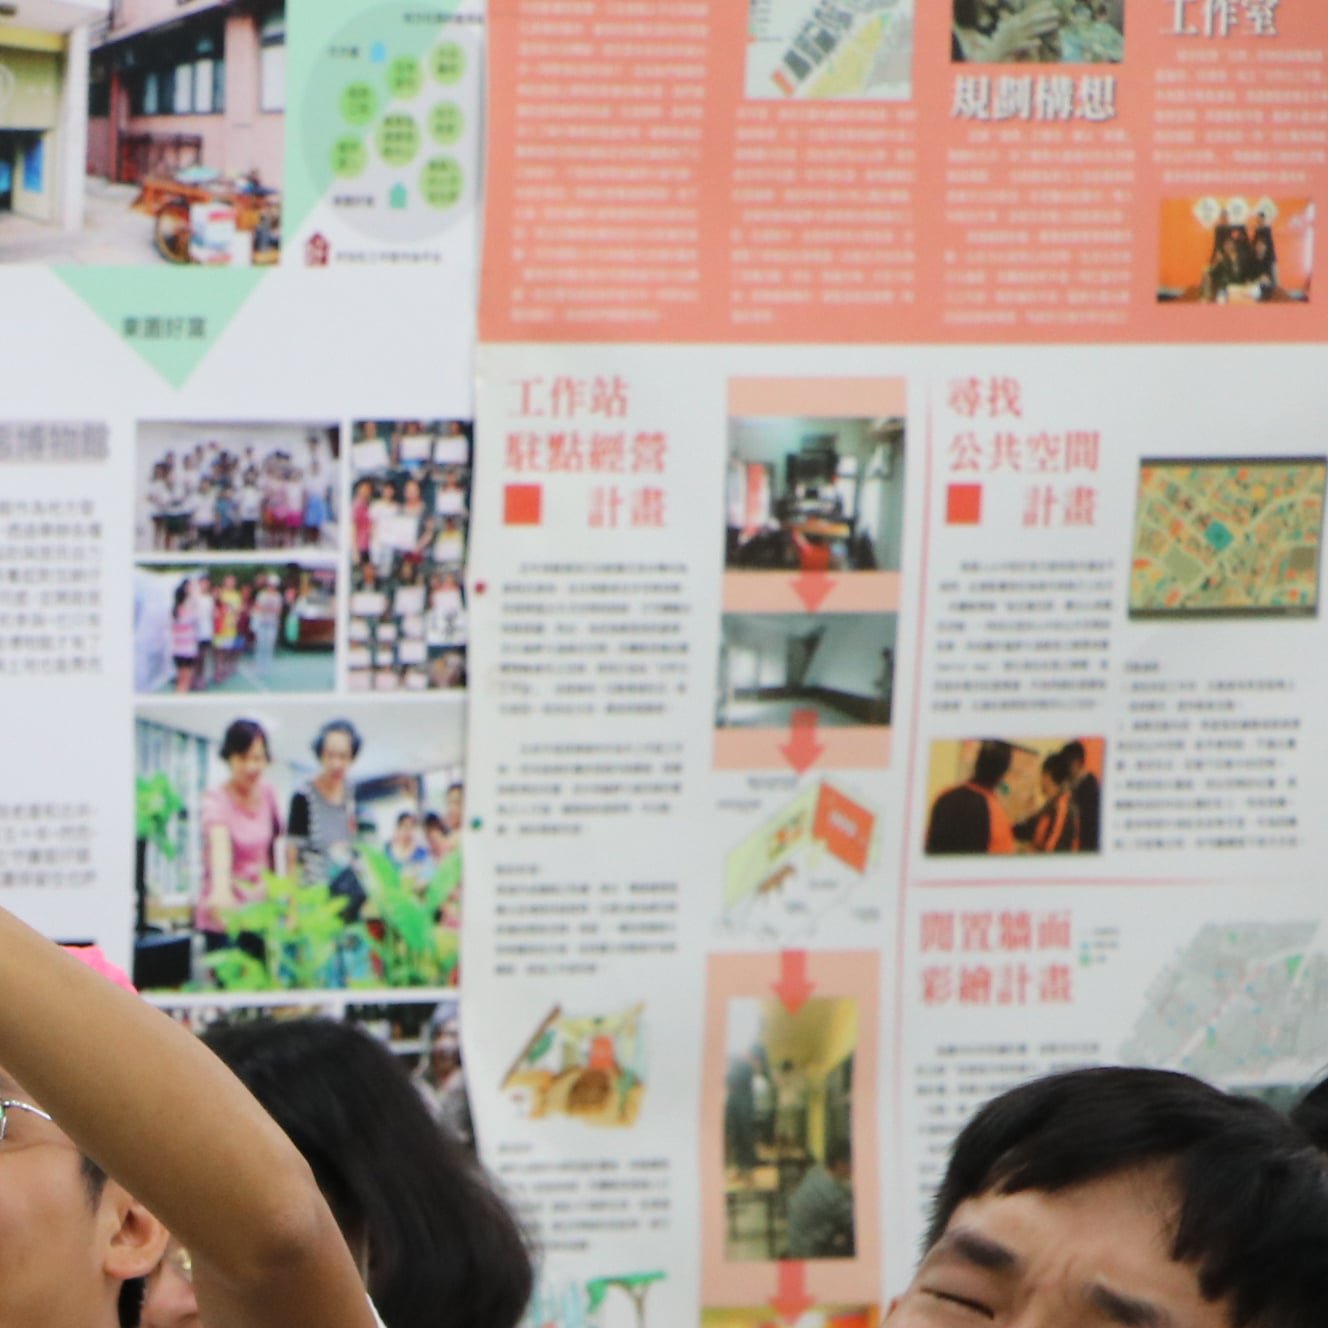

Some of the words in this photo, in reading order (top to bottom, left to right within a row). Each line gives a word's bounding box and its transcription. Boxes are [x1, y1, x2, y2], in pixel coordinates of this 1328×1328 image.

[951, 75, 1118, 121] 規劃構想
[507, 374, 631, 419] 工作站
[948, 375, 1023, 418] 尋找
[505, 430, 668, 474] 駐點經營
[949, 430, 1101, 474] 公共空間
[587, 484, 666, 528] 計畫
[1021, 484, 1098, 528] 計畫
[921, 964, 1074, 1006] 彩繪計畫
